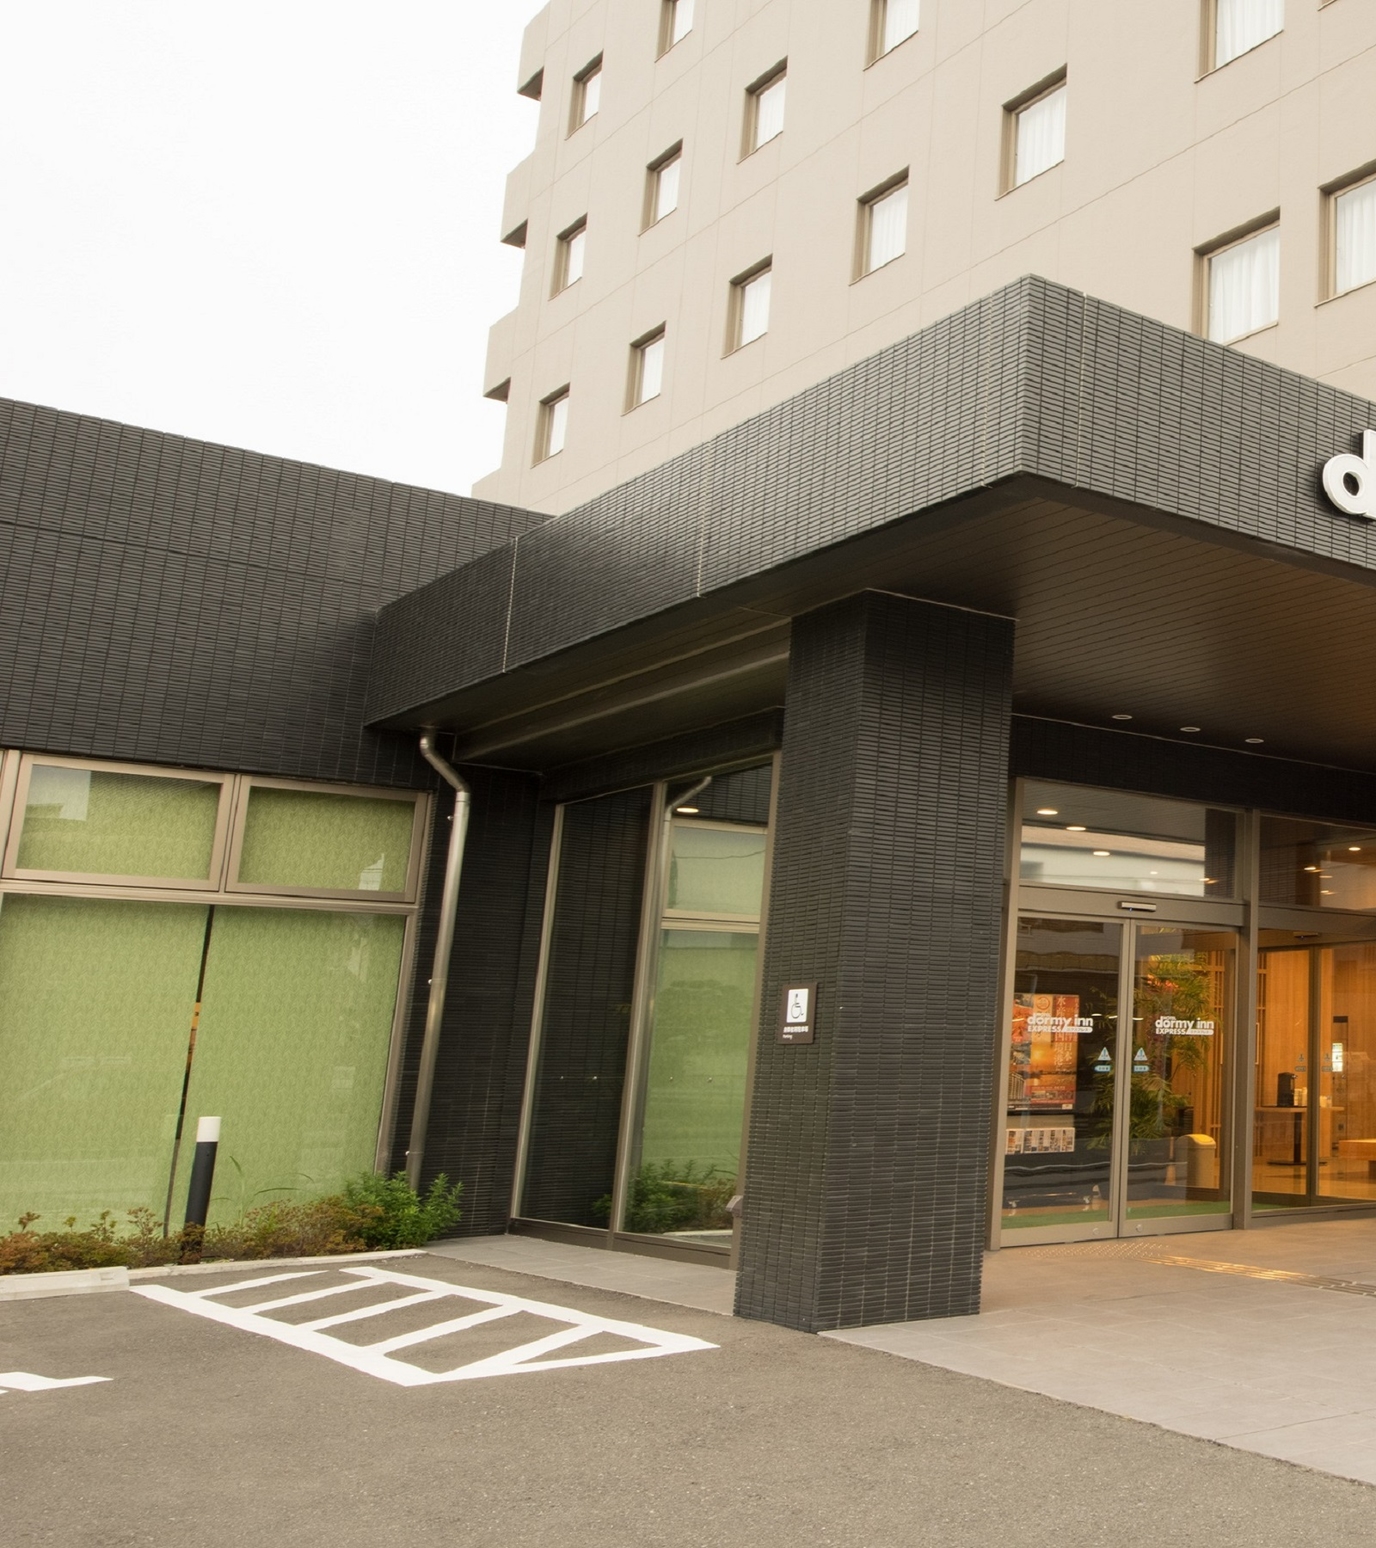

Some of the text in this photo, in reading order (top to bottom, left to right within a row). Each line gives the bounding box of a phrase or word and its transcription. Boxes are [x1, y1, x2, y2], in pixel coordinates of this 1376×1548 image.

[1027, 1013, 1094, 1028] dormy inn
[1155, 1016, 1215, 1029] dormy inn
